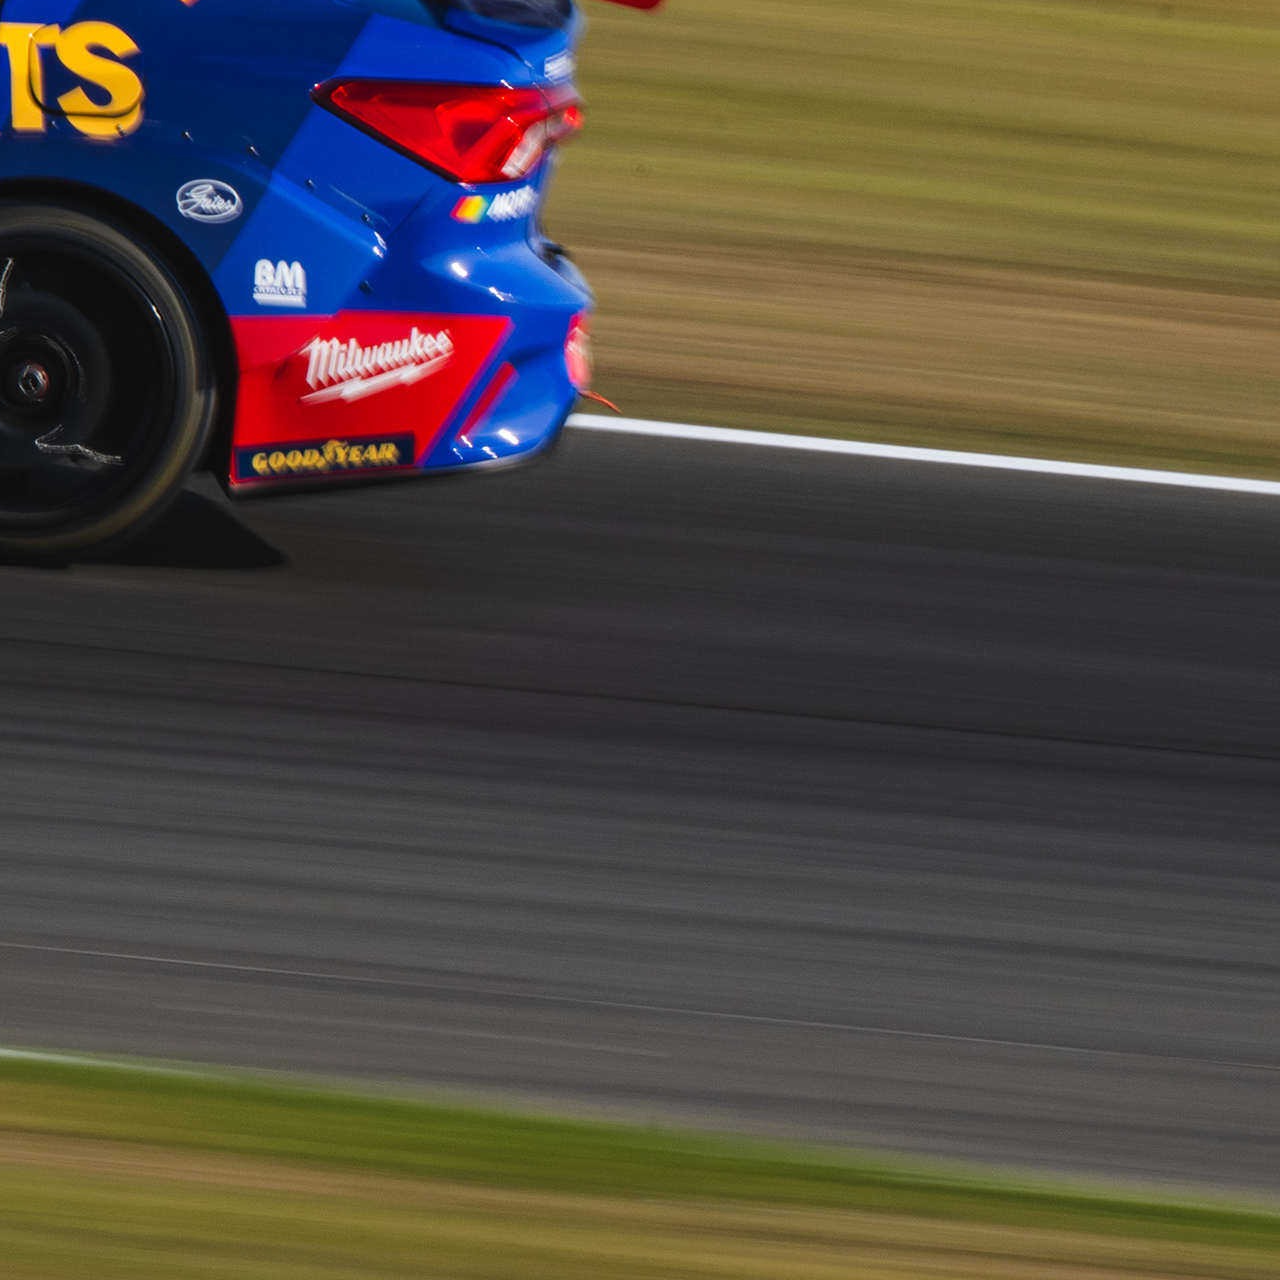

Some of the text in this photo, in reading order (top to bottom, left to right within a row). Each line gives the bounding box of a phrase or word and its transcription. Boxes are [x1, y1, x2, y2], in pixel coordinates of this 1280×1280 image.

[254, 258, 308, 289] BM
[297, 326, 455, 393] Milwaukee
[251, 439, 402, 476] GOODYEAR
